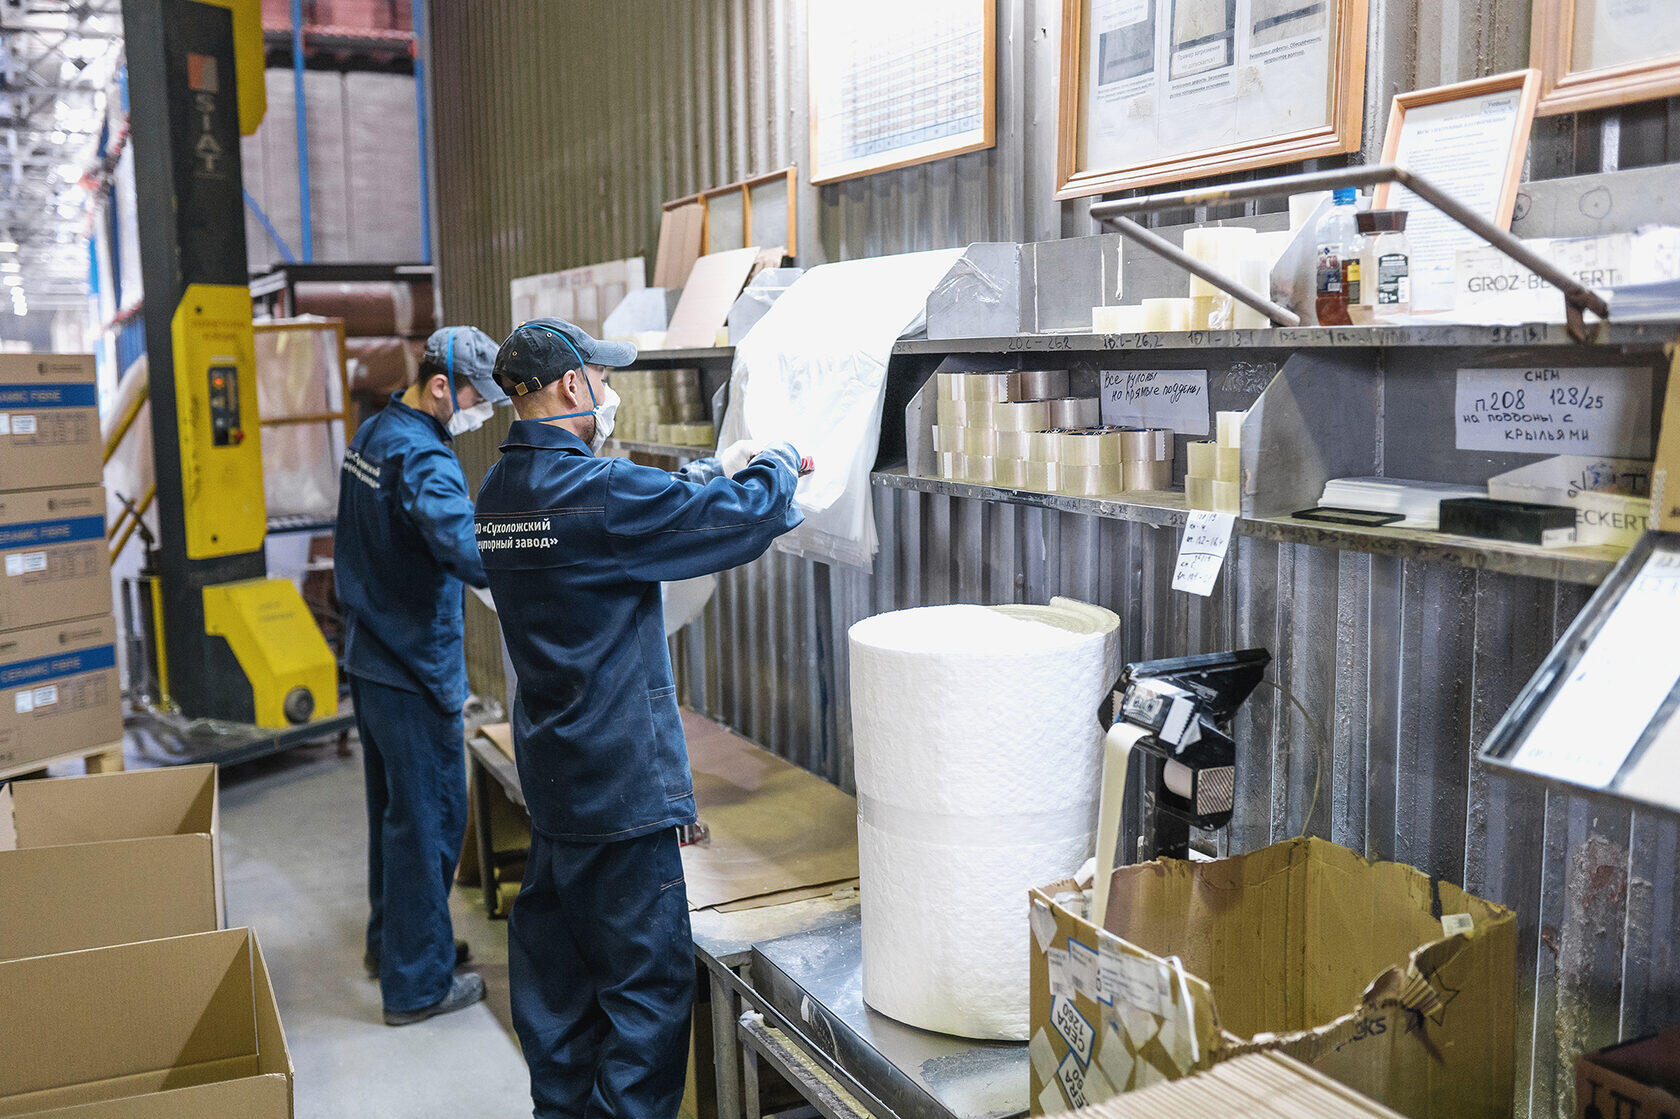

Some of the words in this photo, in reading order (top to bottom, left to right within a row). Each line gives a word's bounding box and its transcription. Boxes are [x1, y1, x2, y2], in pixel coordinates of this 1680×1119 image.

[1550, 386, 1604, 409] 128/25
[1464, 415, 1480, 423] на
[483, 518, 551, 537] «Сухоложский
[515, 537, 559, 550] завод»
[1062, 1003, 1085, 1036] 1260
[1057, 1010, 1086, 1054] CERA
